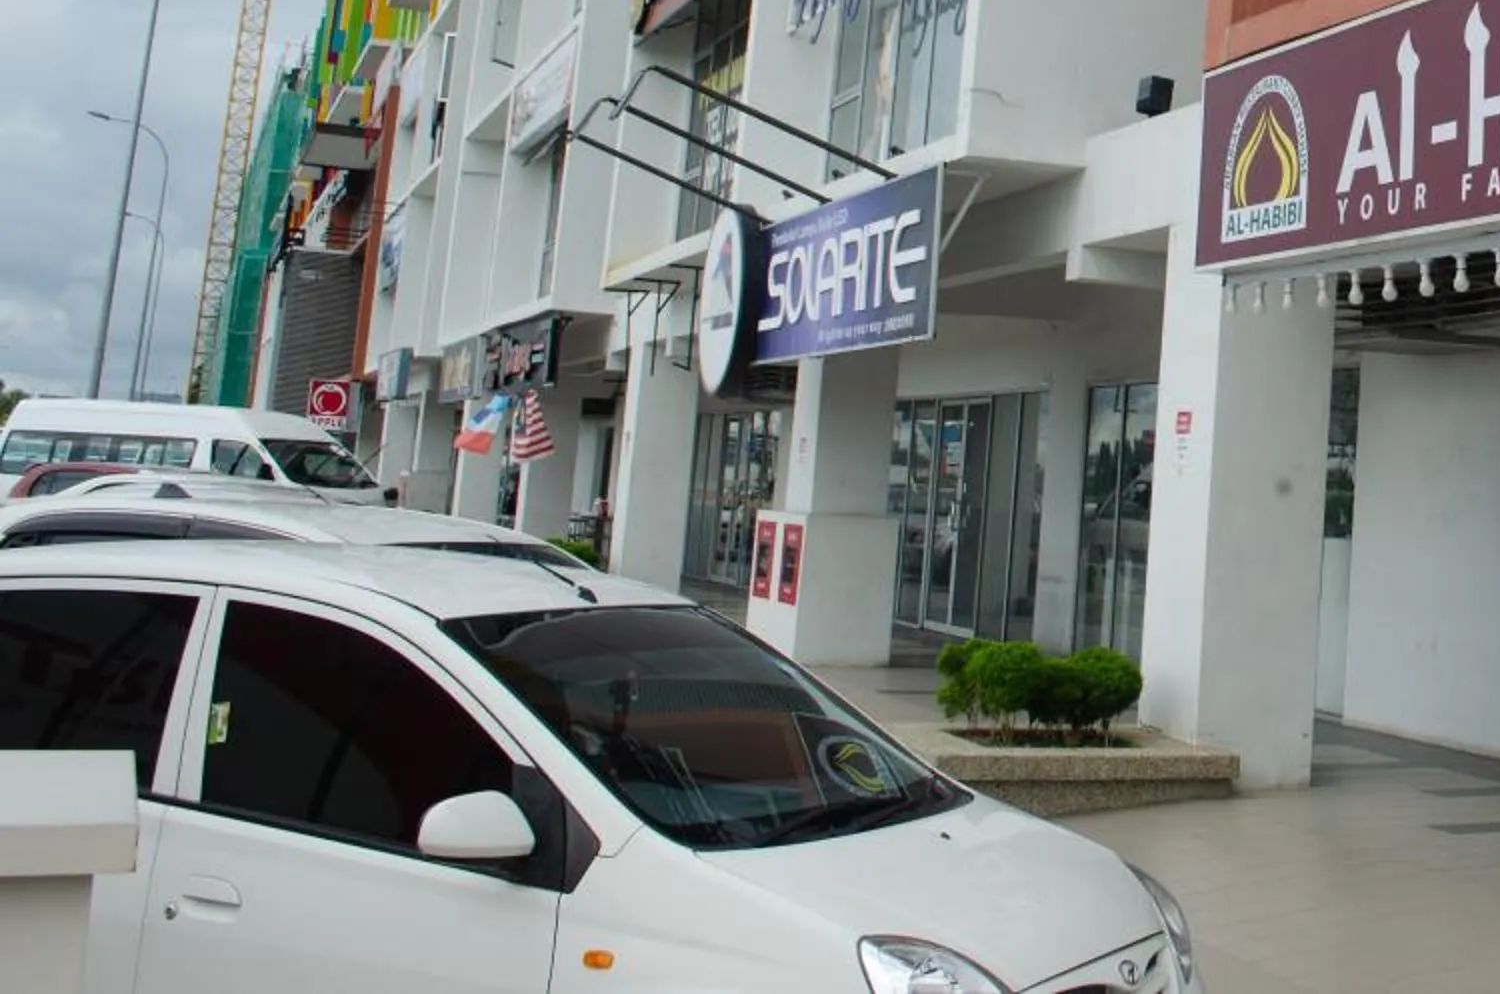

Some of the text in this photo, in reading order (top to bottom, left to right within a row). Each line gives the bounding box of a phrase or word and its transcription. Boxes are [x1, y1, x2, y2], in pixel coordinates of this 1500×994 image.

[1225, 198, 1303, 239] AL-HABIBI
[1337, 181, 1427, 226] YOUR
[757, 208, 928, 333] SOLARITE
